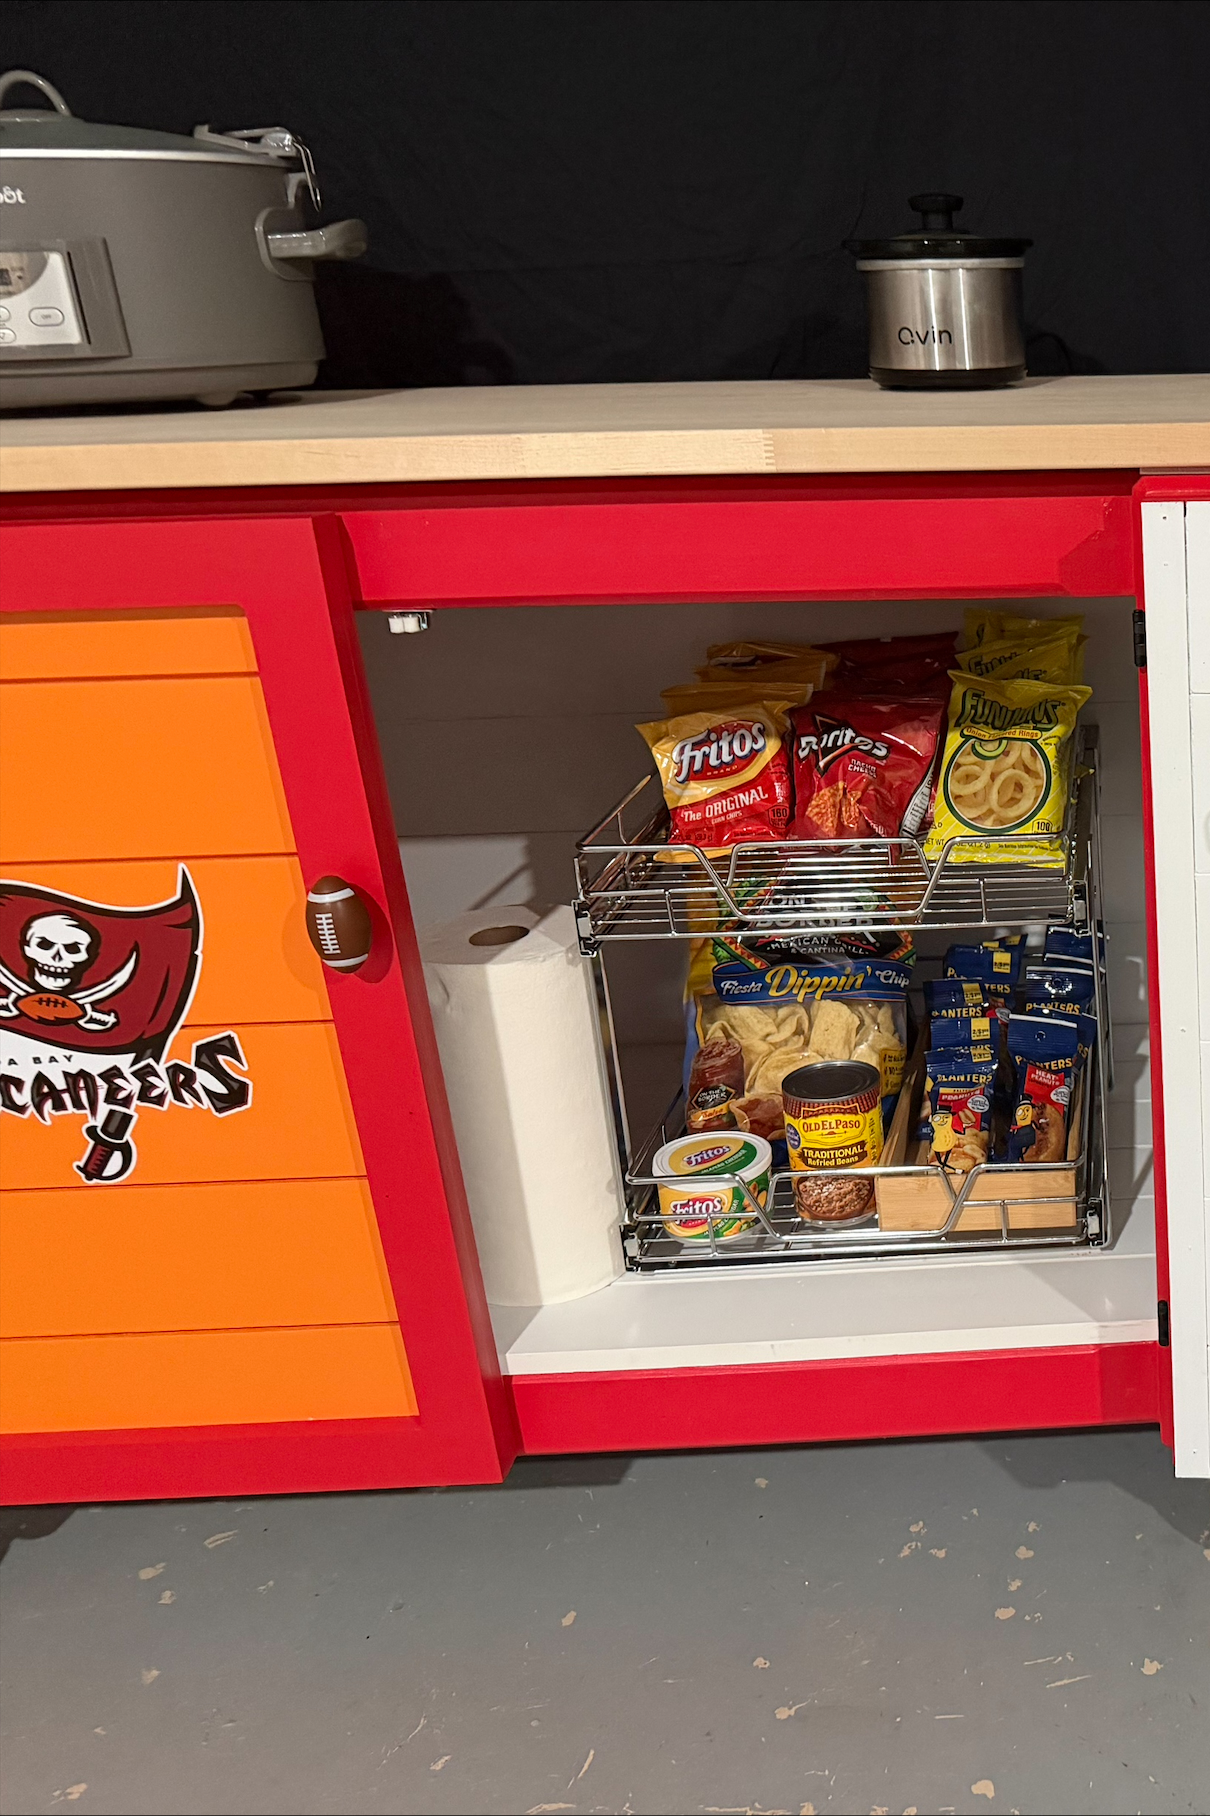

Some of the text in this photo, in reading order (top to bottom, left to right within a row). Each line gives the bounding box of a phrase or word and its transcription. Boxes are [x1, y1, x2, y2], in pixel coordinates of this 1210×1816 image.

[966, 727, 986, 738] Onion
[798, 727, 889, 759] Doritos
[672, 722, 766, 783] Fritos
[681, 810, 702, 822] The
[705, 786, 768, 818] ORIGINAL
[771, 936, 829, 950] MEXICAN
[798, 946, 845, 955] CANTINA
[720, 979, 763, 995] Fiesta
[765, 965, 872, 1003] Dippin'
[32, 1054, 74, 1065] BAY
[1015, 1055, 1073, 1071] PNTERS
[936, 1073, 993, 1086] PLANTERS
[802, 1121, 821, 1133] OLD
[821, 1120, 834, 1131] EL
[683, 1146, 731, 1167] Fritos
[802, 1145, 864, 1159] TRADITIONAL
[807, 1156, 859, 1167] Refried Beans
[670, 1197, 722, 1225] Fritos
